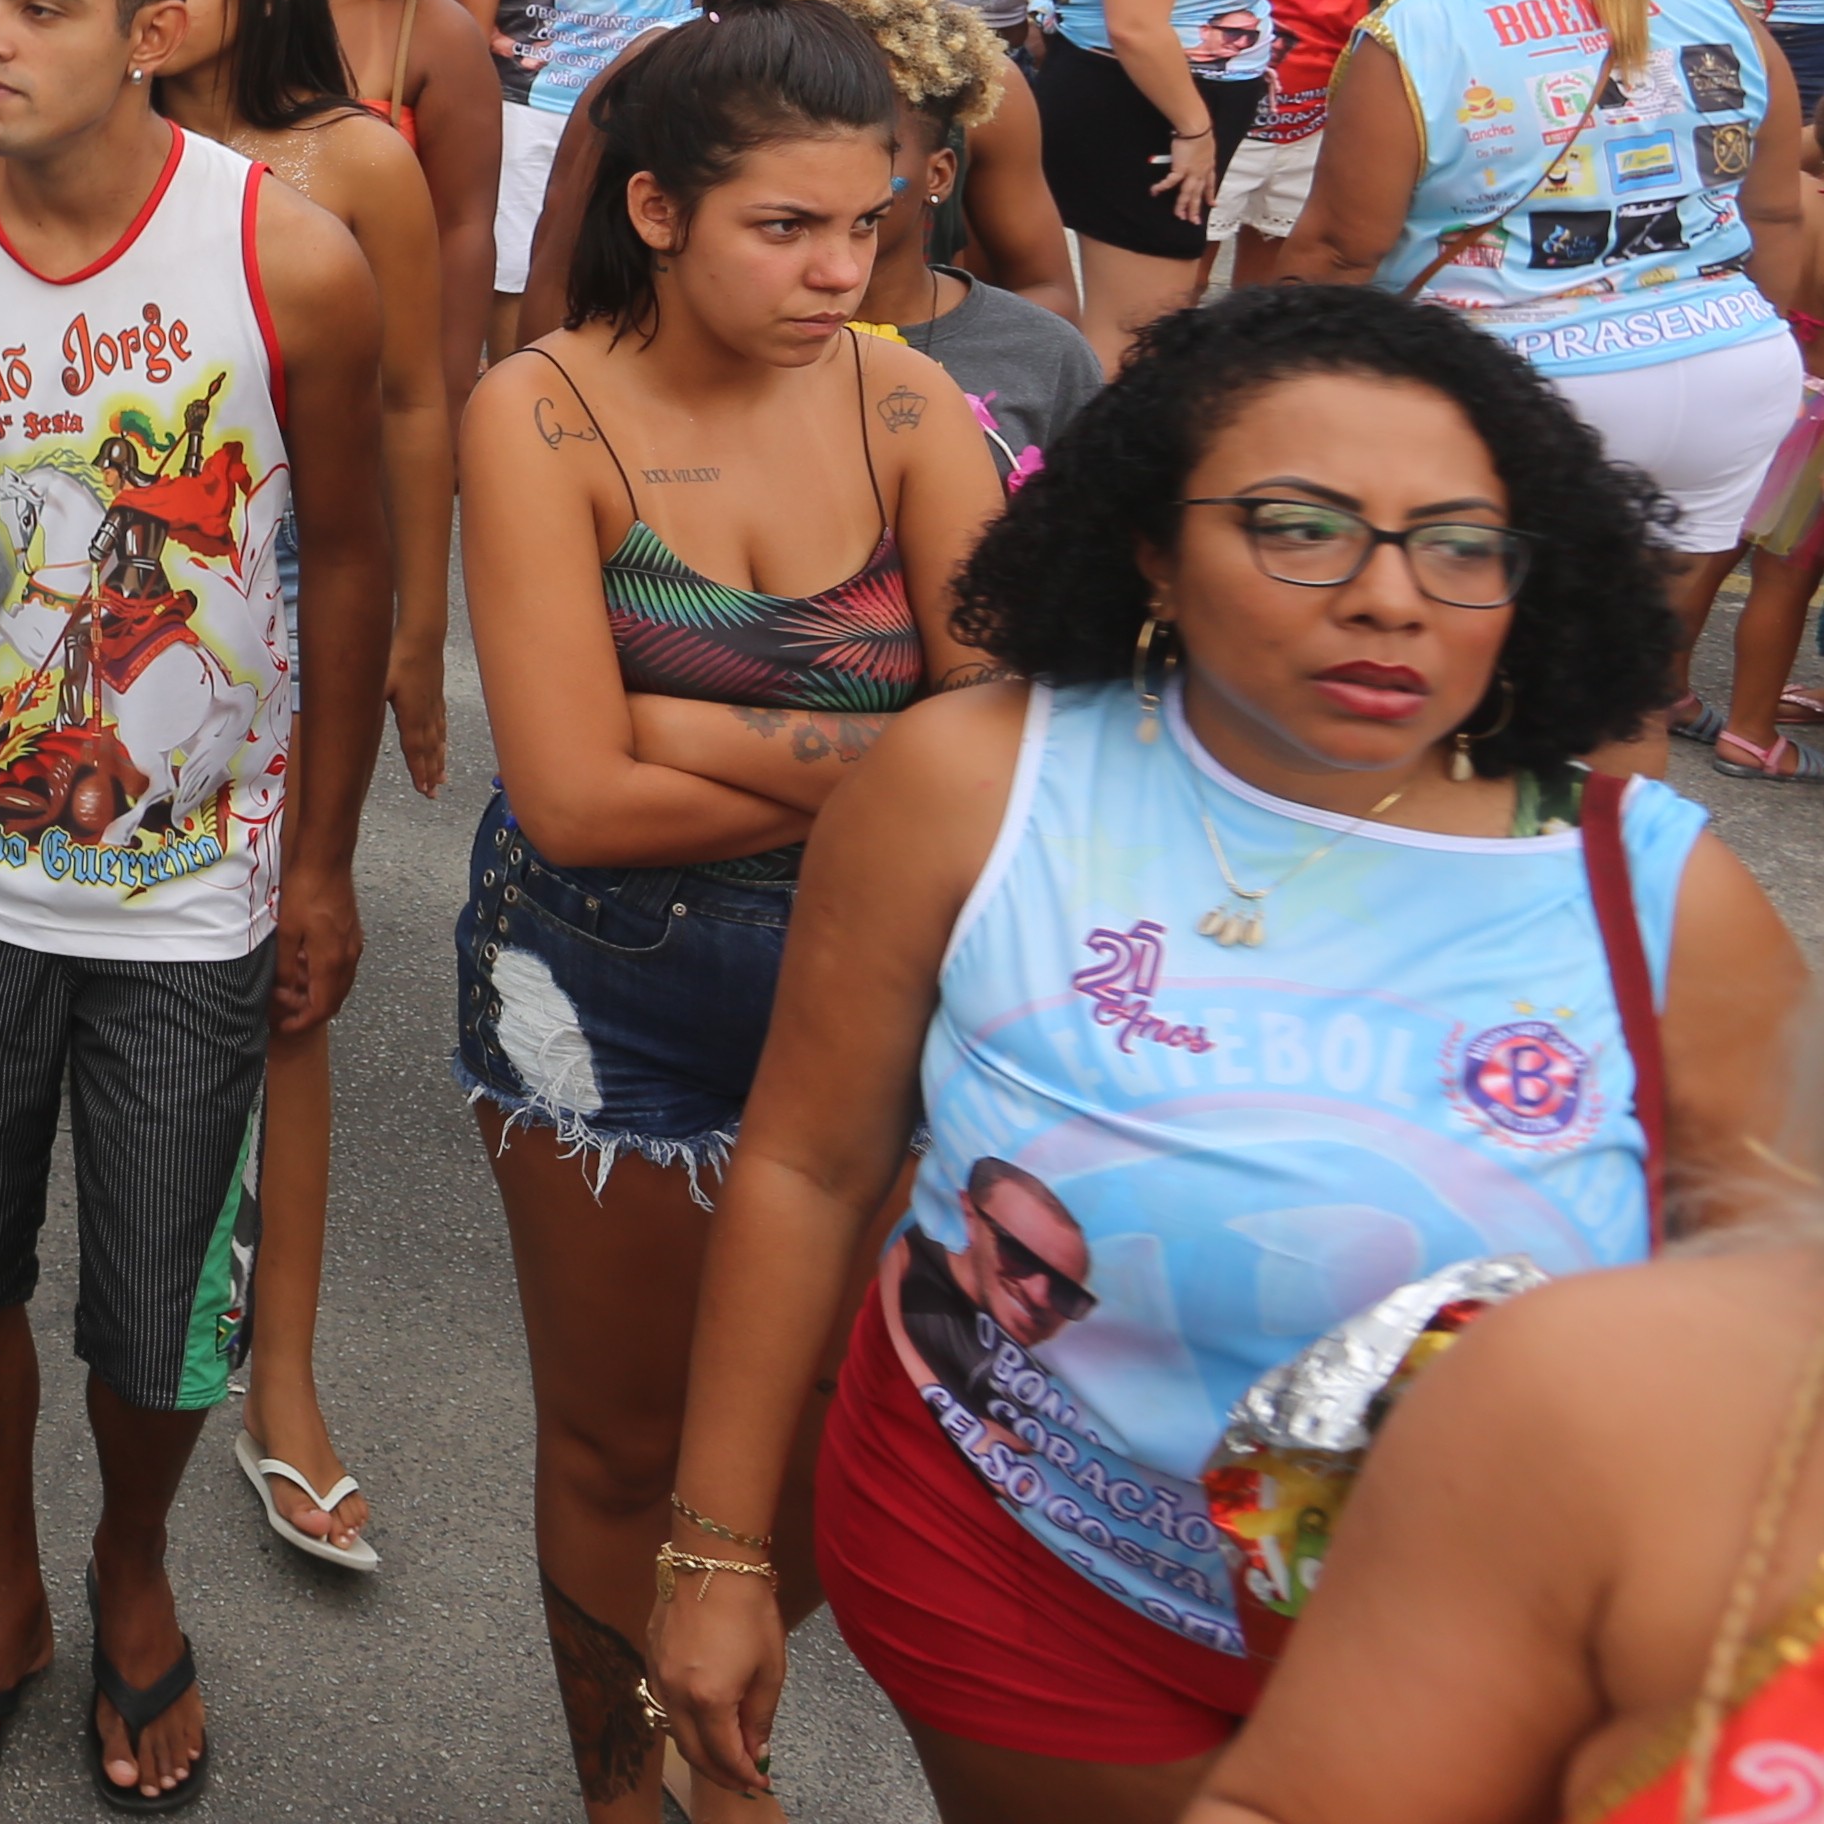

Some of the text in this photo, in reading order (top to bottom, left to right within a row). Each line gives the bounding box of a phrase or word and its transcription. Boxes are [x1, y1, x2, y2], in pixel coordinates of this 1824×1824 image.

[512, 42, 554, 62] CELSO
[61, 303, 193, 398] Jorge
[41, 827, 222, 889] Guerreiro
[1093, 994, 1214, 1054] Anos
[921, 1384, 1043, 1505] CELSO
[987, 1399, 1220, 1553] CORAÇÃO
